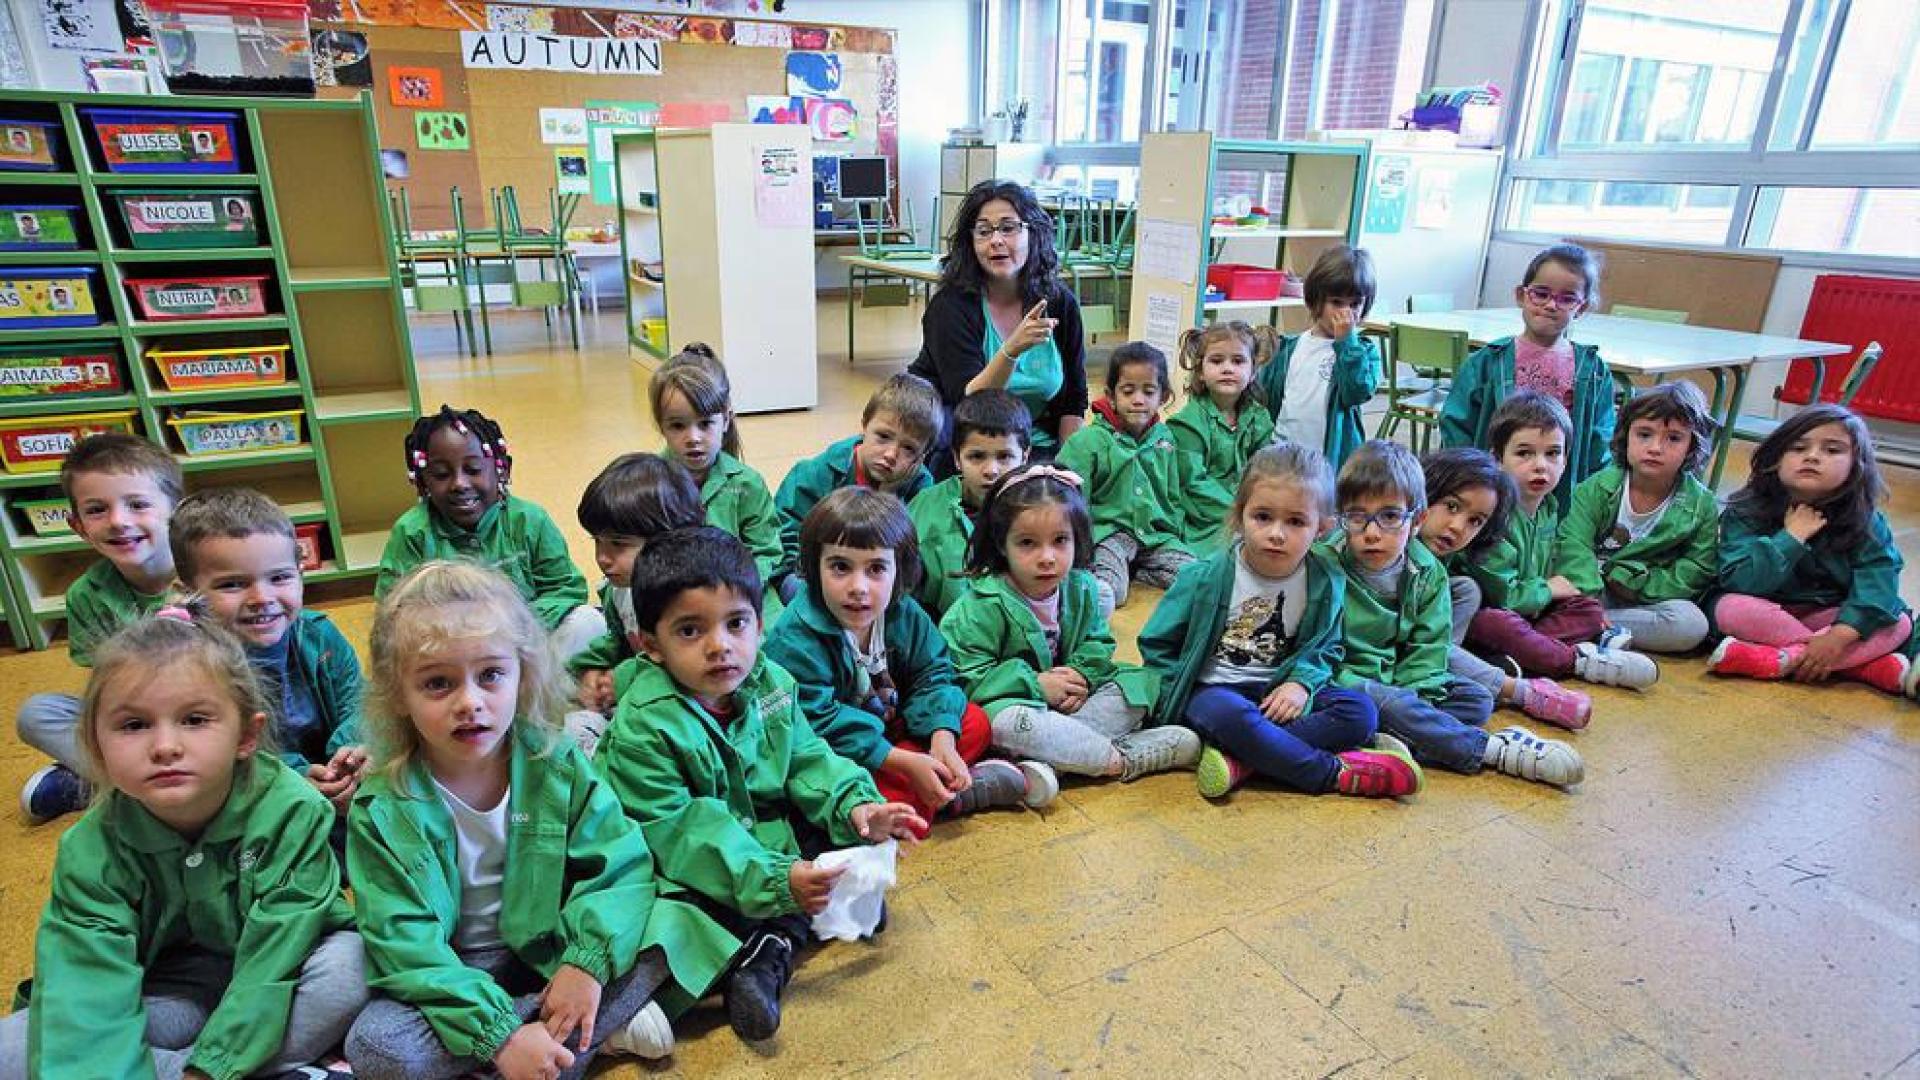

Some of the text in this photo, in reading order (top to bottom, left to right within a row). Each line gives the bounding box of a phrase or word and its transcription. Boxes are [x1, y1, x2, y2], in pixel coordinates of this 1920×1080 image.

[470, 34, 660, 70] AUTUMN
[121, 134, 180, 149] ULISES
[145, 205, 211, 220] NICOLE
[157, 290, 214, 305] NURIA
[172, 361, 257, 376] MARIAMA
[202, 426, 255, 442] PAULA
